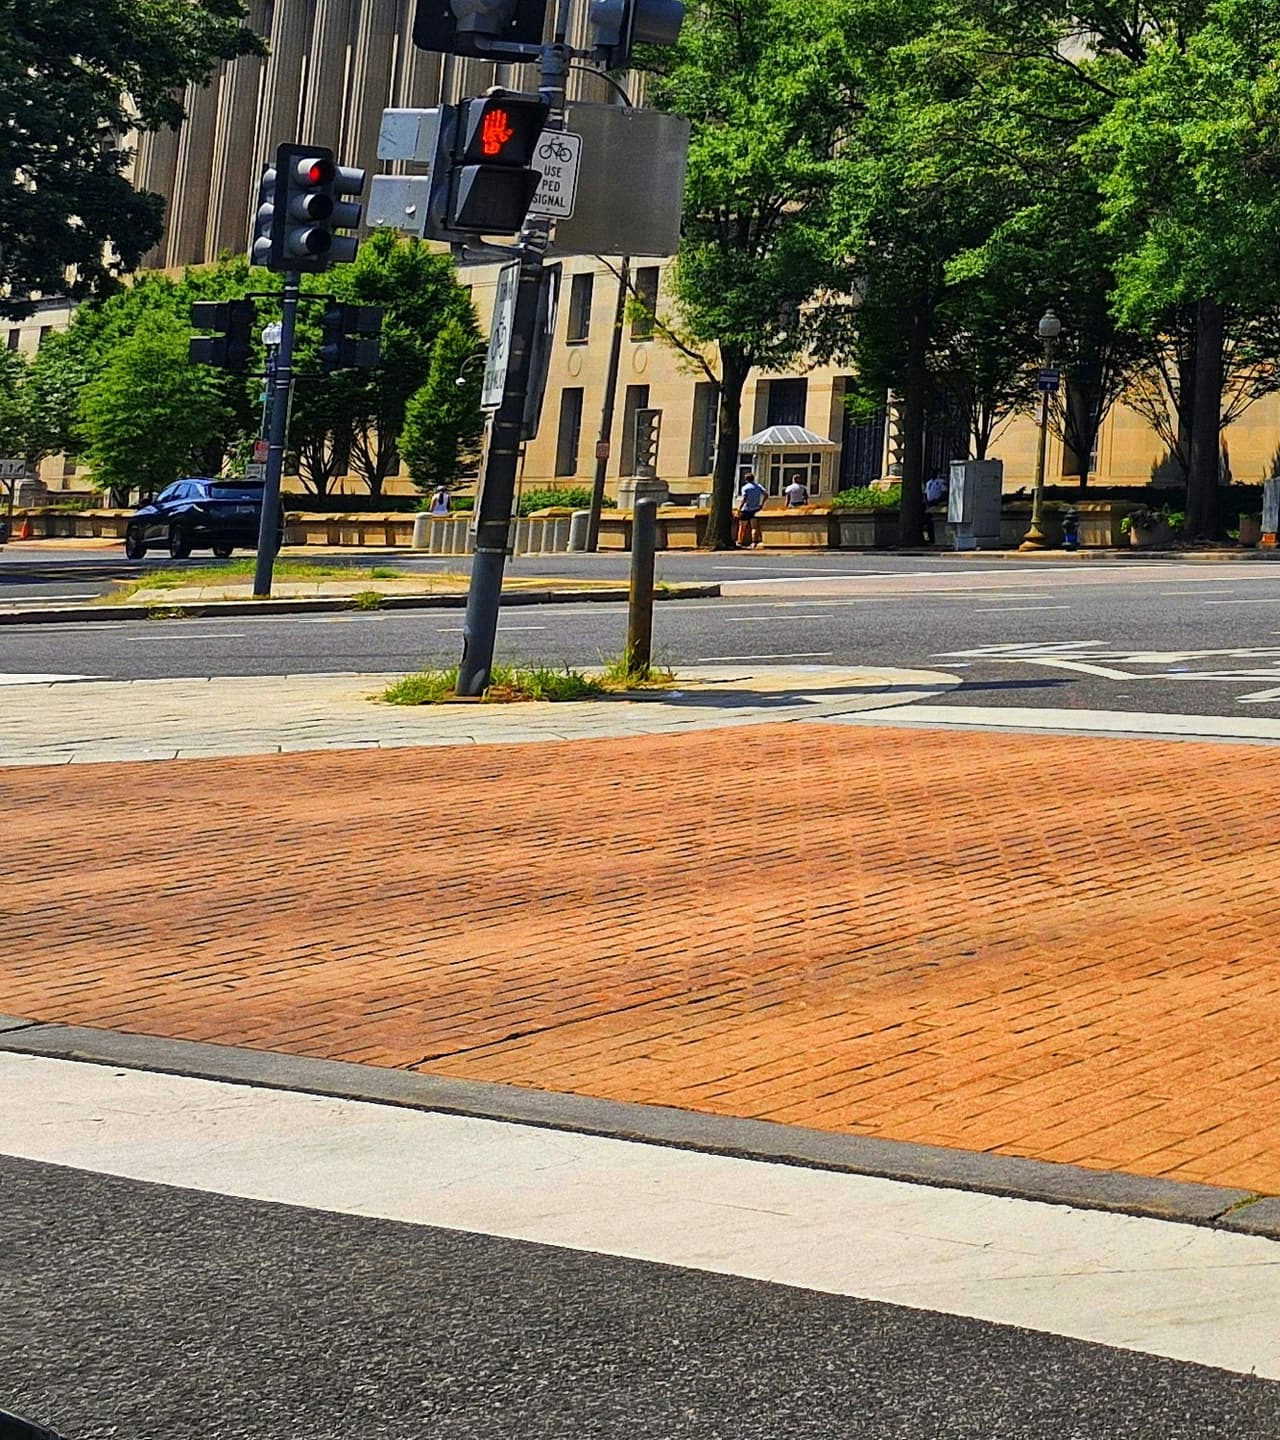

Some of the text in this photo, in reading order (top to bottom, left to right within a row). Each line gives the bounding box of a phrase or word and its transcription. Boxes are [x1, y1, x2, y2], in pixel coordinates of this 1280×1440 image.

[544, 164, 563, 178] USE
[541, 179, 561, 192] PED
[532, 192, 566, 208] SIGNAL
